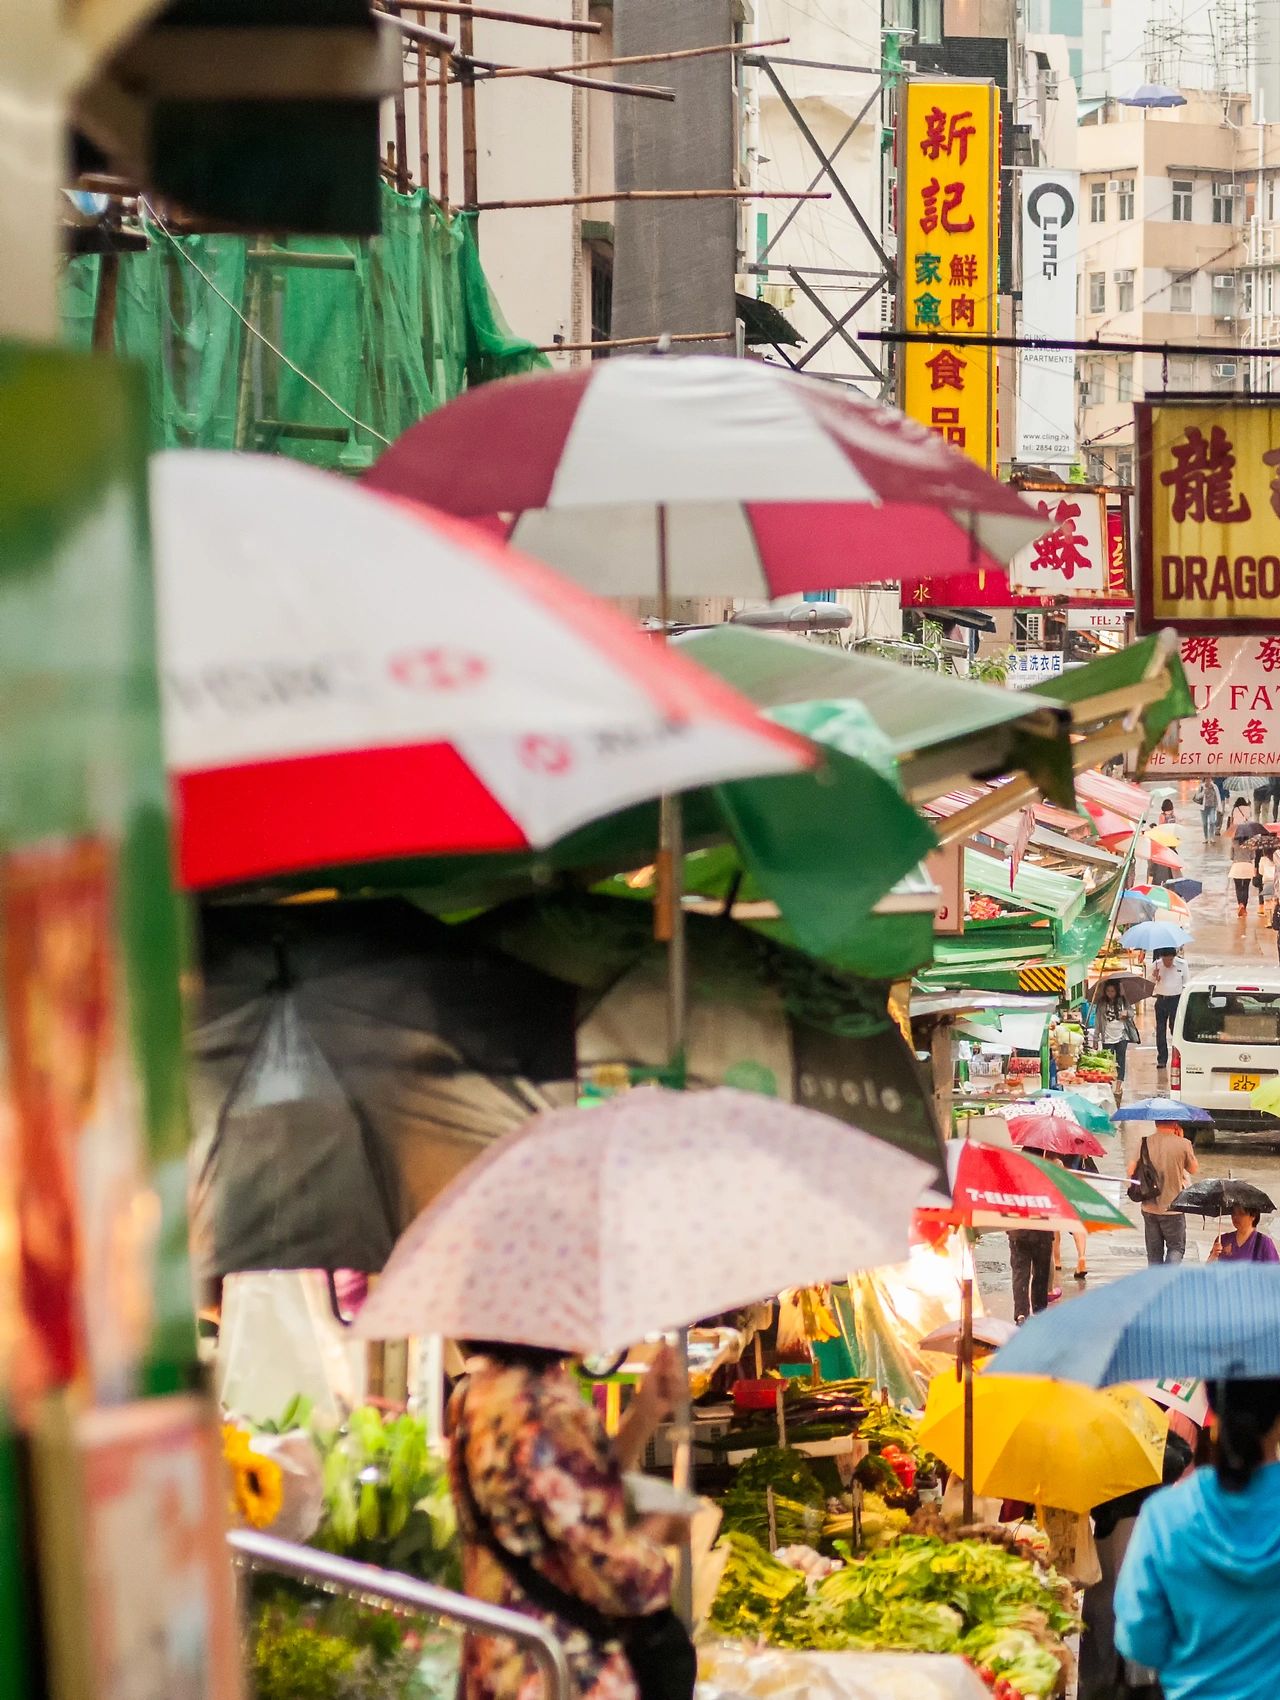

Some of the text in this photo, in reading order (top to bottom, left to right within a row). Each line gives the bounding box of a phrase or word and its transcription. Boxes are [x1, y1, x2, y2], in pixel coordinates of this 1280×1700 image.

[919, 106, 976, 236] 新記
[1023, 354, 1073, 364] APARTMENTS
[1207, 752, 1224, 765] OF
[1237, 1075, 1251, 1083] JL
[1233, 1082, 1256, 1092] 247
